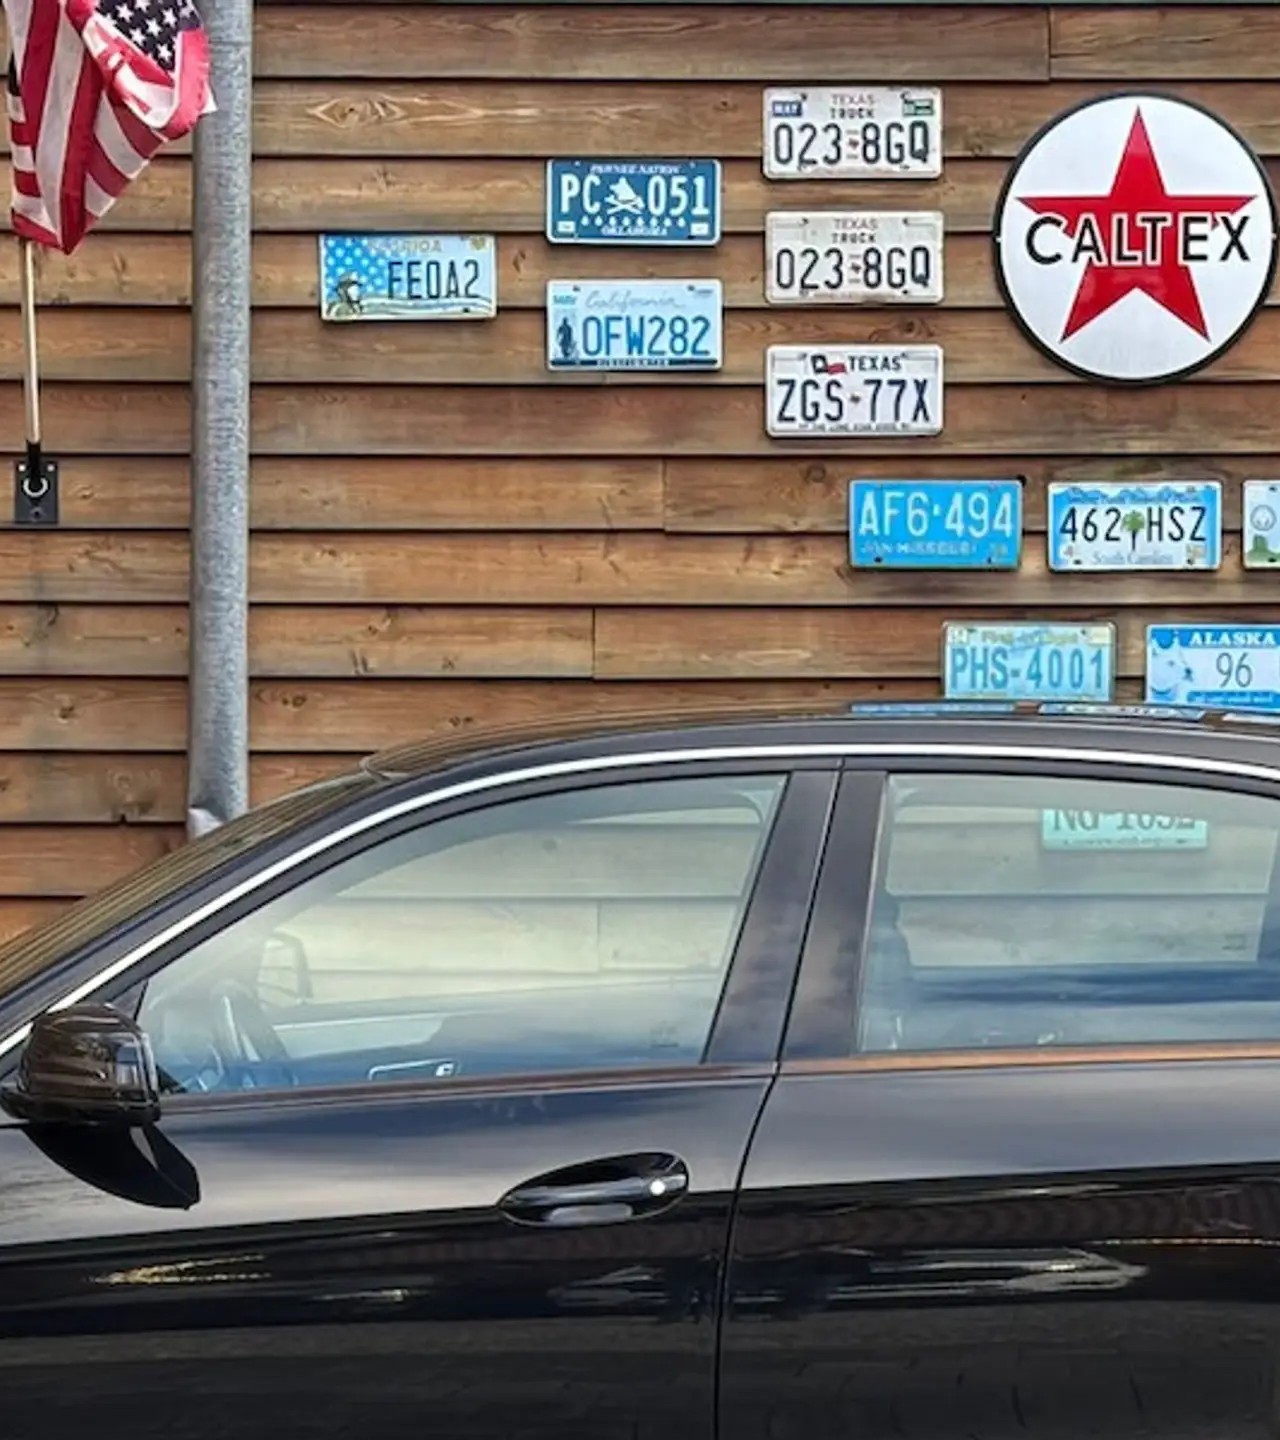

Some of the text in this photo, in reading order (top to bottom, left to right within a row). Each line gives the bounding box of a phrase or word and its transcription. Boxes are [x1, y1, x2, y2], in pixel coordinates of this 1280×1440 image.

[829, 106, 876, 119] TRUCK
[831, 232, 877, 244] TRUCK
[1025, 214, 1252, 266] CALTEX
[847, 355, 903, 371] TEXAS
[1189, 631, 1277, 646] ALASKA
[1215, 651, 1253, 688] 96
